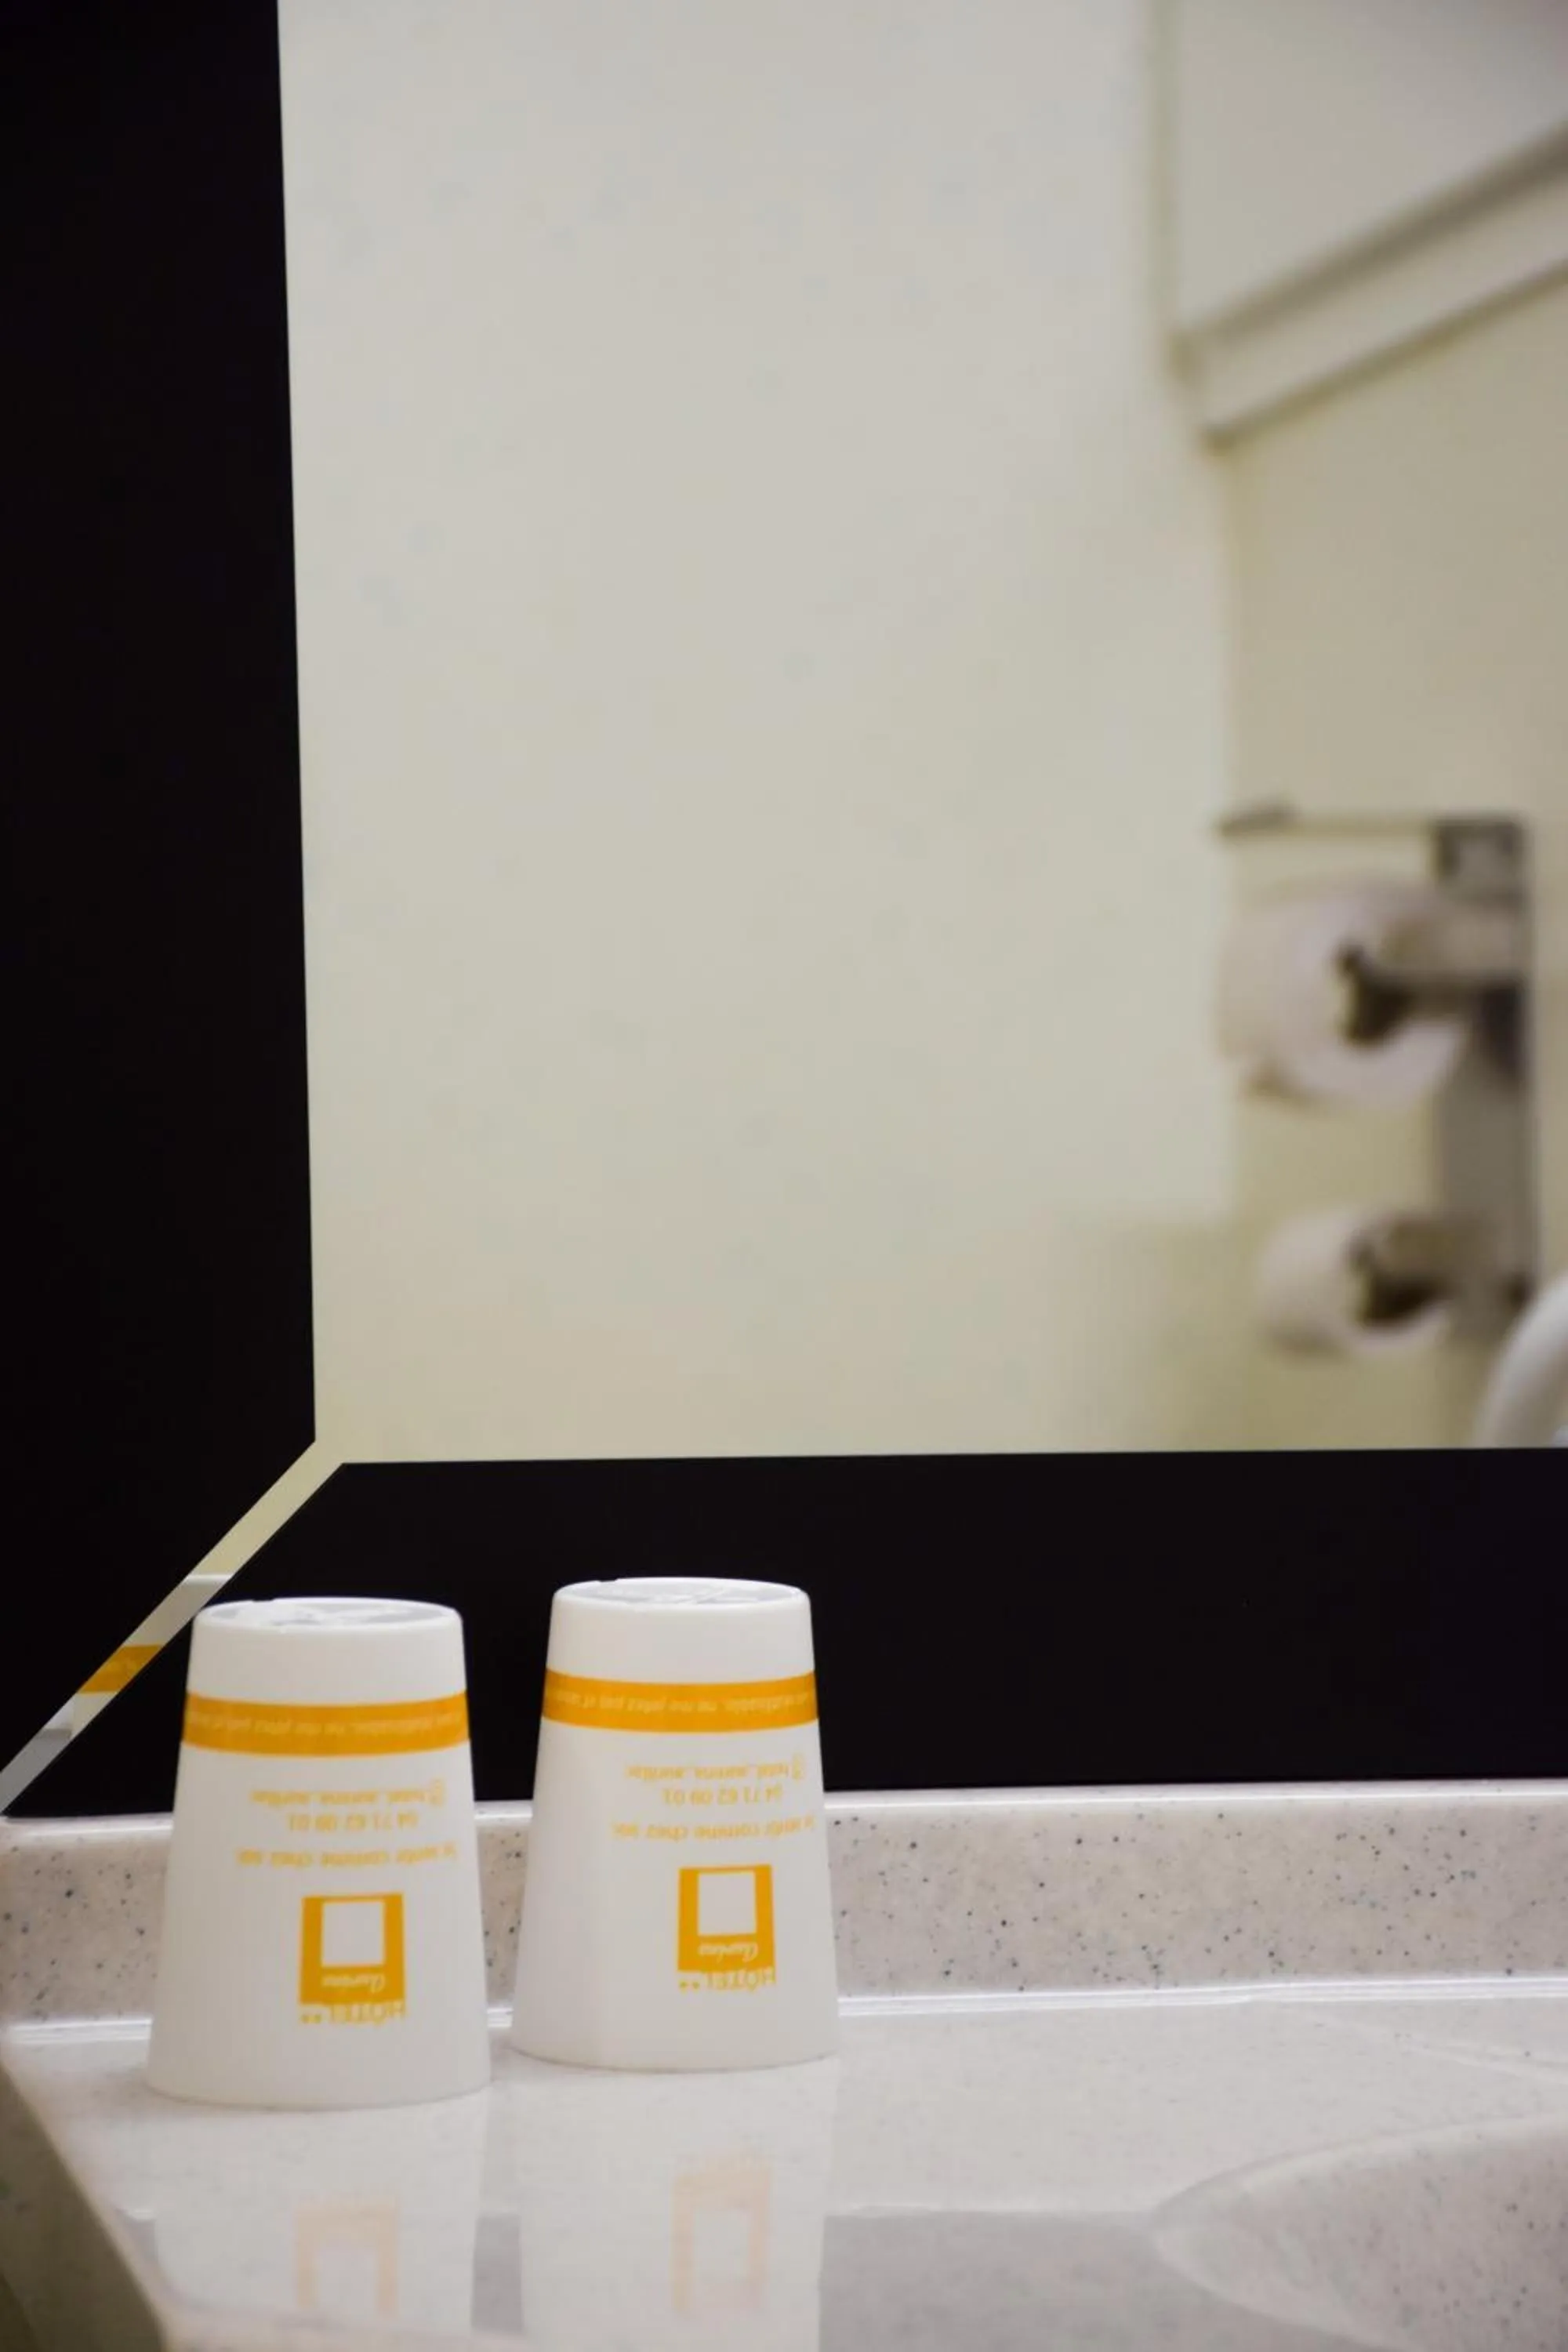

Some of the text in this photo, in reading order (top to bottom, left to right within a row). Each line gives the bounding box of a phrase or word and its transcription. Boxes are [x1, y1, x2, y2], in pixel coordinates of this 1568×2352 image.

[647, 1825, 688, 1842] chez
[694, 1824, 760, 1840] comme
[321, 1851, 390, 1867] comme
